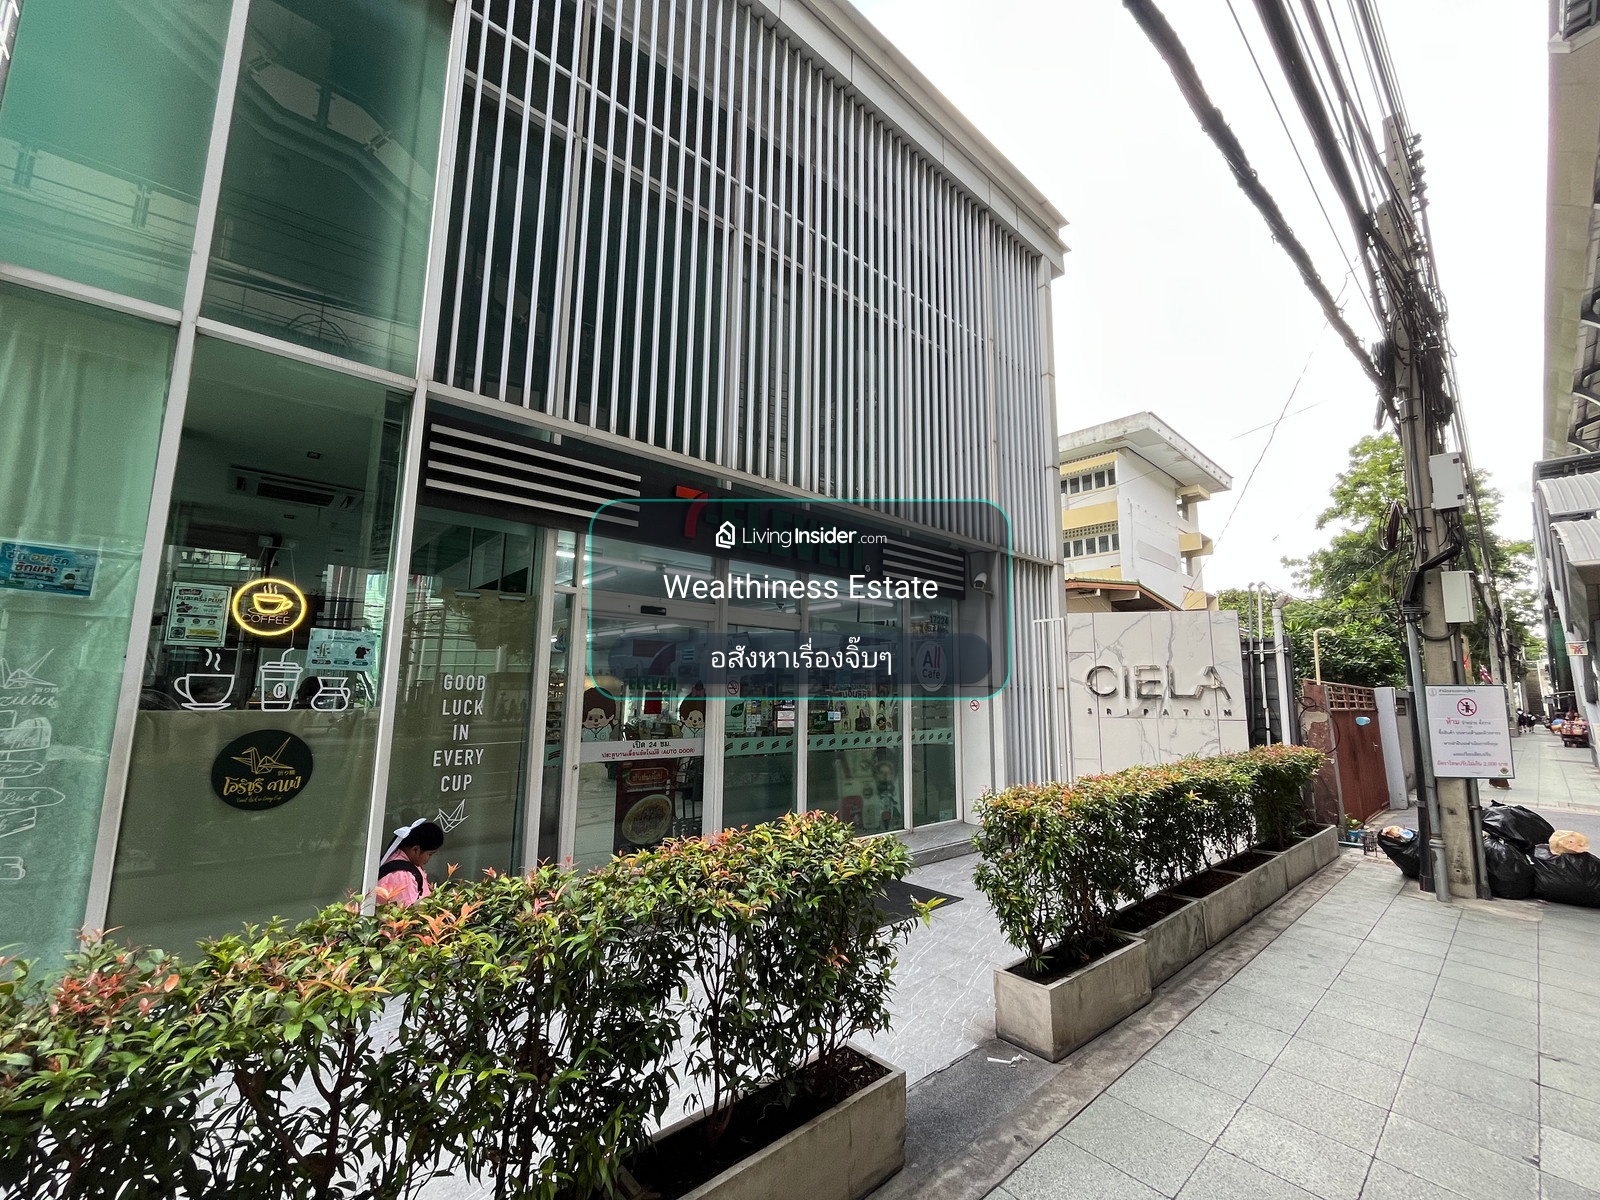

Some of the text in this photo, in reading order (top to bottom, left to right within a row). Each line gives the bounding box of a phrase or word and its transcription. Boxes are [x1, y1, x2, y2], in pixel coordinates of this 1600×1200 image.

[242, 613, 291, 625] COFFEE
[922, 646, 941, 668] All
[443, 674, 487, 691] GOOD
[1086, 665, 1232, 700] CIELA
[442, 699, 484, 716] LUCK
[1087, 707, 1233, 717] SRIPATUM
[452, 724, 470, 741] IN
[632, 740, 646, 749] เปิด
[433, 749, 484, 767] EVERY
[440, 774, 473, 792] CUP
